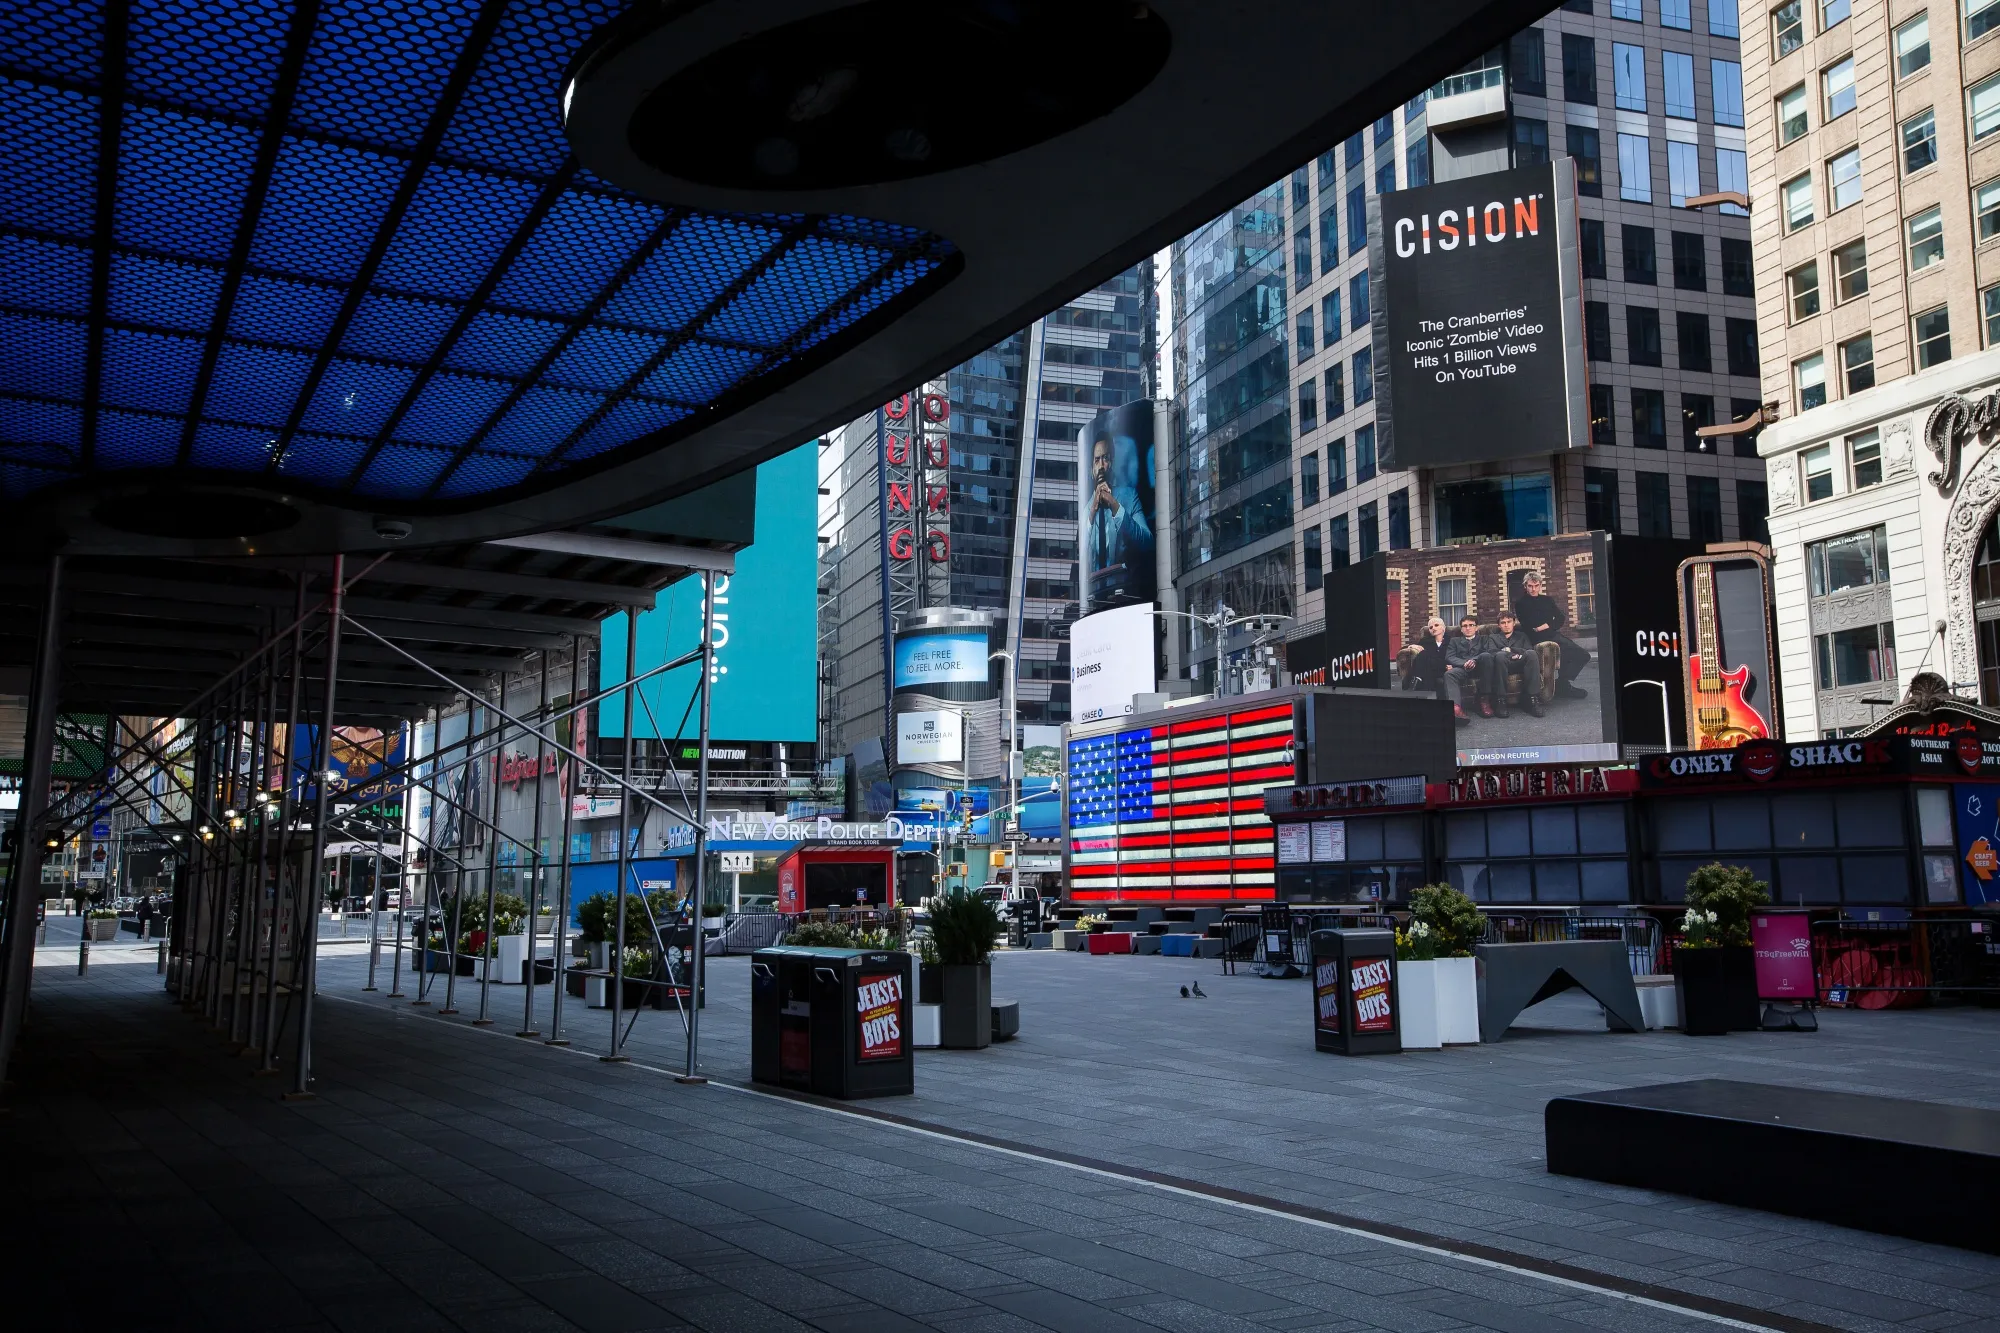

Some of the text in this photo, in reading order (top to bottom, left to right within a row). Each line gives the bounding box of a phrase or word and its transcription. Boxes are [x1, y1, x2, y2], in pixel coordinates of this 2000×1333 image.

[1419, 306, 1527, 333] The Cranberries'
[1406, 323, 1544, 352] Iconic 'Zombie' Video
[1414, 341, 1537, 369] Hits 1 Billion Views
[1435, 362, 1517, 383] On YouTube
[1827, 533, 1871, 548] DAKTRONICS
[913, 649, 951, 661] FEEL FREE
[1332, 649, 1374, 681] CISION
[906, 660, 964, 674] TO FEEL MORE.
[1076, 662, 1102, 678] Business
[1294, 667, 1325, 687] CISION
[1081, 710, 1097, 720] CHASE
[905, 732, 953, 741] NORWEGIAN
[1910, 738, 1951, 749] SOUTHEAST
[707, 749, 747, 760] RADITION
[1470, 751, 1540, 761] THOMSON REUTERS
[1789, 740, 1893, 768] SHACK
[1920, 752, 1943, 763] ASIAN
[1651, 753, 1735, 779] CONEY
[1447, 767, 1609, 801] TAQUERIA
[1790, 938, 1811, 946] FREE
[1316, 961, 1338, 988] JERSEY
[1351, 959, 1392, 991] JERSEY
[857, 975, 902, 1012] JERSEY
[1319, 994, 1338, 1019] BOYS
[1356, 992, 1390, 1022] BOYS
[862, 1013, 900, 1048] BOYS
